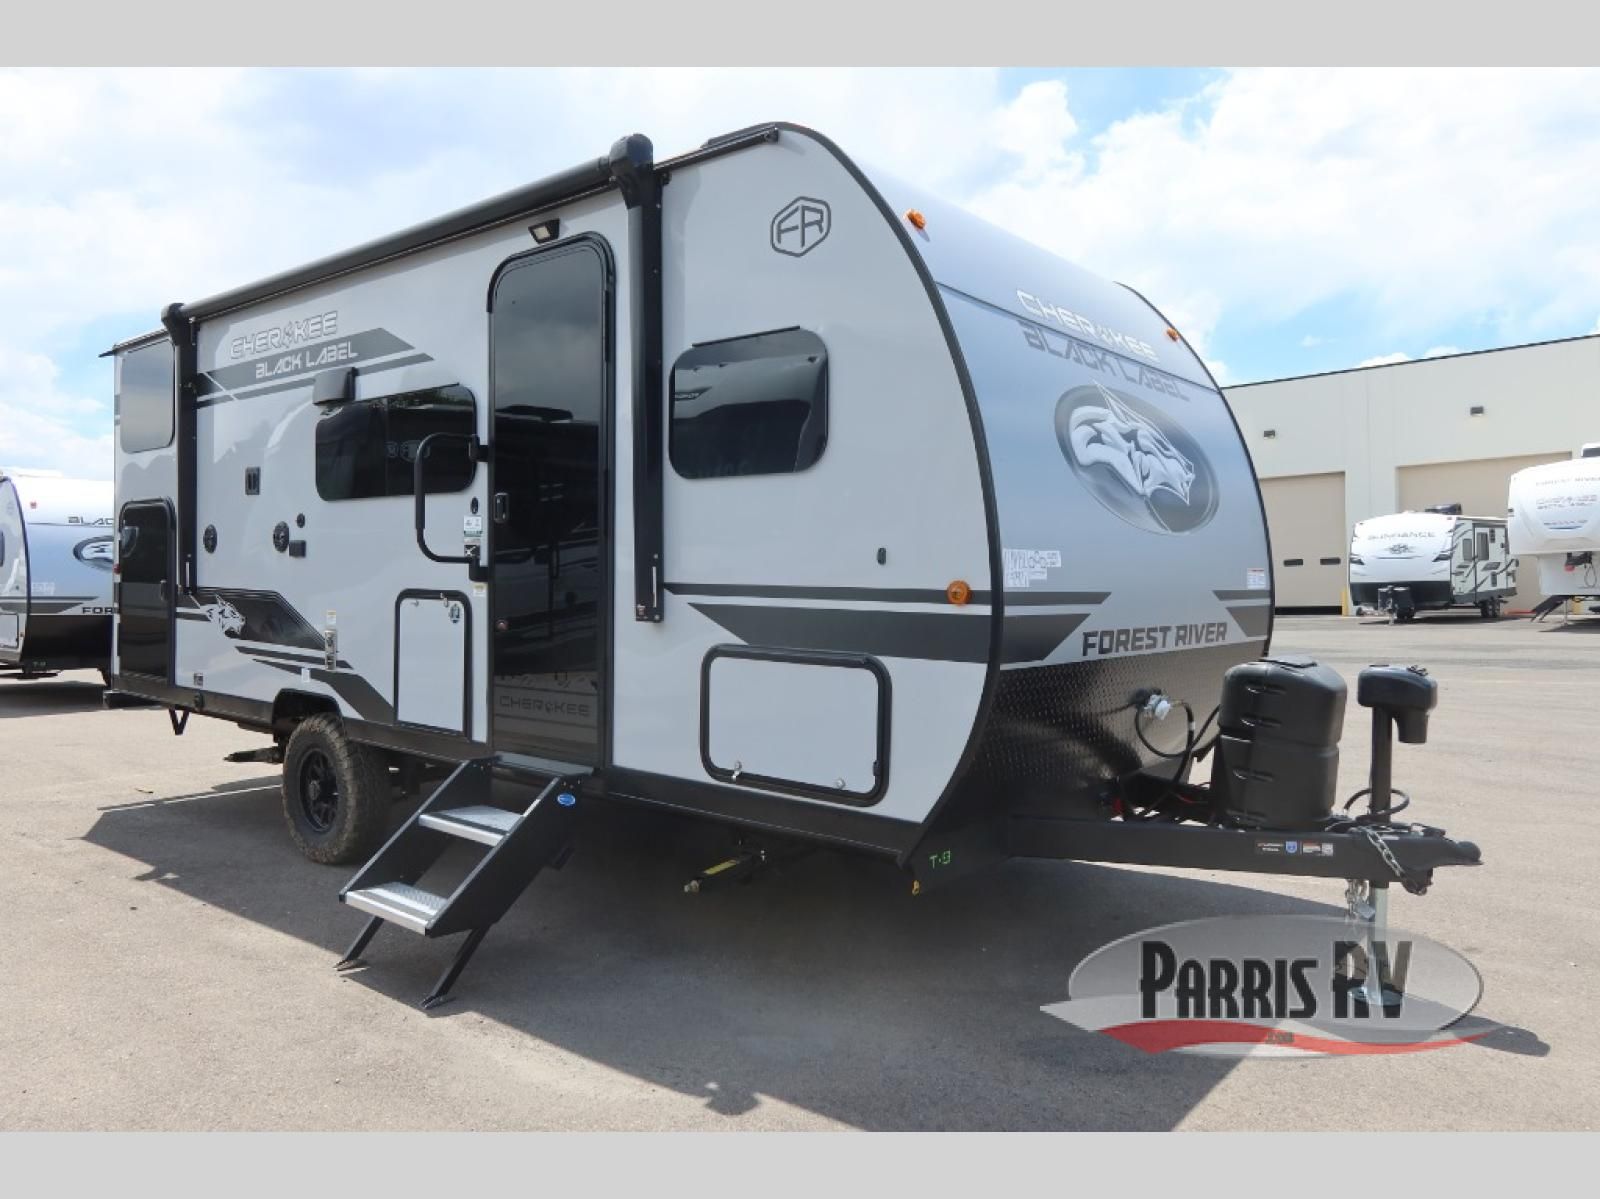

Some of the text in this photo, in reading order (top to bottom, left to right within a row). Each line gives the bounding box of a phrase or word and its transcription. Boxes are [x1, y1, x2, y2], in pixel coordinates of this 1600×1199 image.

[230, 310, 338, 360] CHEROKEE
[1016, 289, 1161, 363] CHEROKEE
[255, 341, 359, 379] BLACK LABEL
[1017, 319, 1191, 402] BLACK LABEL
[67, 516, 113, 526] BLAC
[1082, 621, 1228, 657] FOREST RIVER
